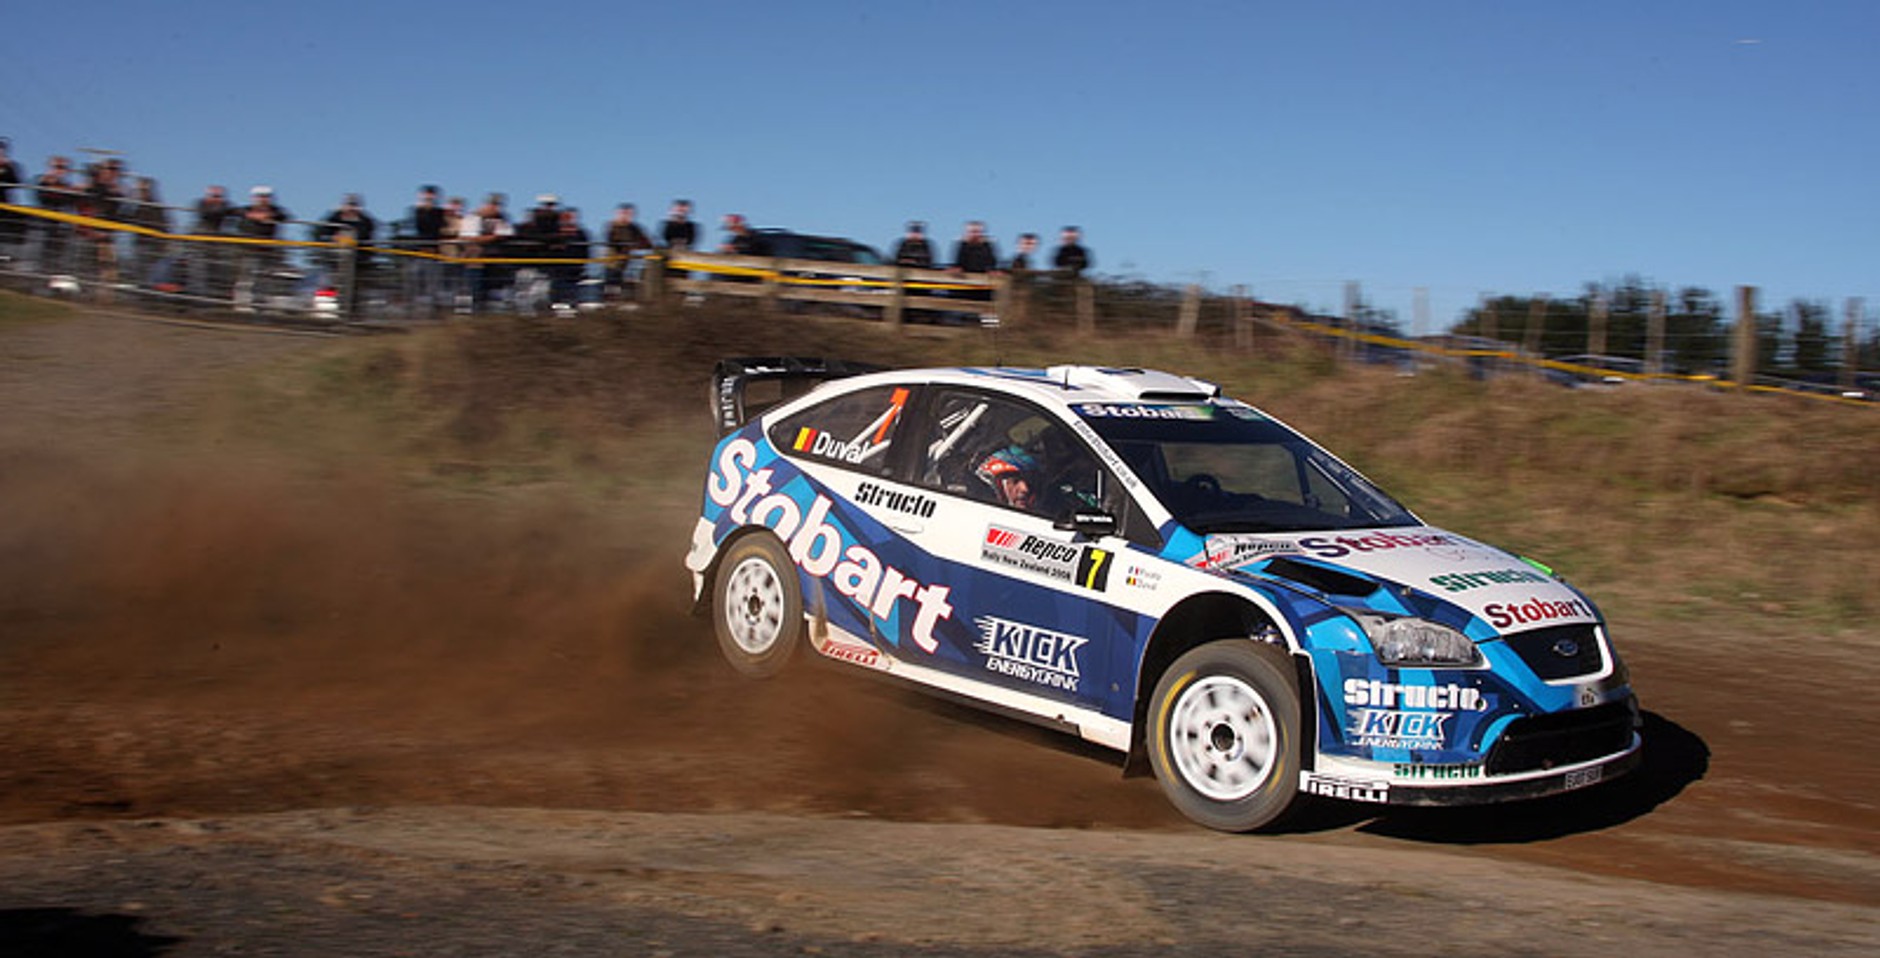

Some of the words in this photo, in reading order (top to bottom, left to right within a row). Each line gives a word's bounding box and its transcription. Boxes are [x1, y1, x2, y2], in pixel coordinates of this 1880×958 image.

[813, 431, 871, 464] Duval
[855, 482, 937, 518] Structo
[708, 438, 953, 654] Stobart
[1019, 535, 1078, 563] Repco
[1086, 550, 1106, 590] 7
[1484, 597, 1592, 628] Stobart
[985, 617, 1089, 678] KICK
[1344, 678, 1487, 712] Structo
[1358, 711, 1450, 739] KICK
[1300, 770, 1390, 803] PIRELLI
[1394, 763, 1471, 779] Structo
